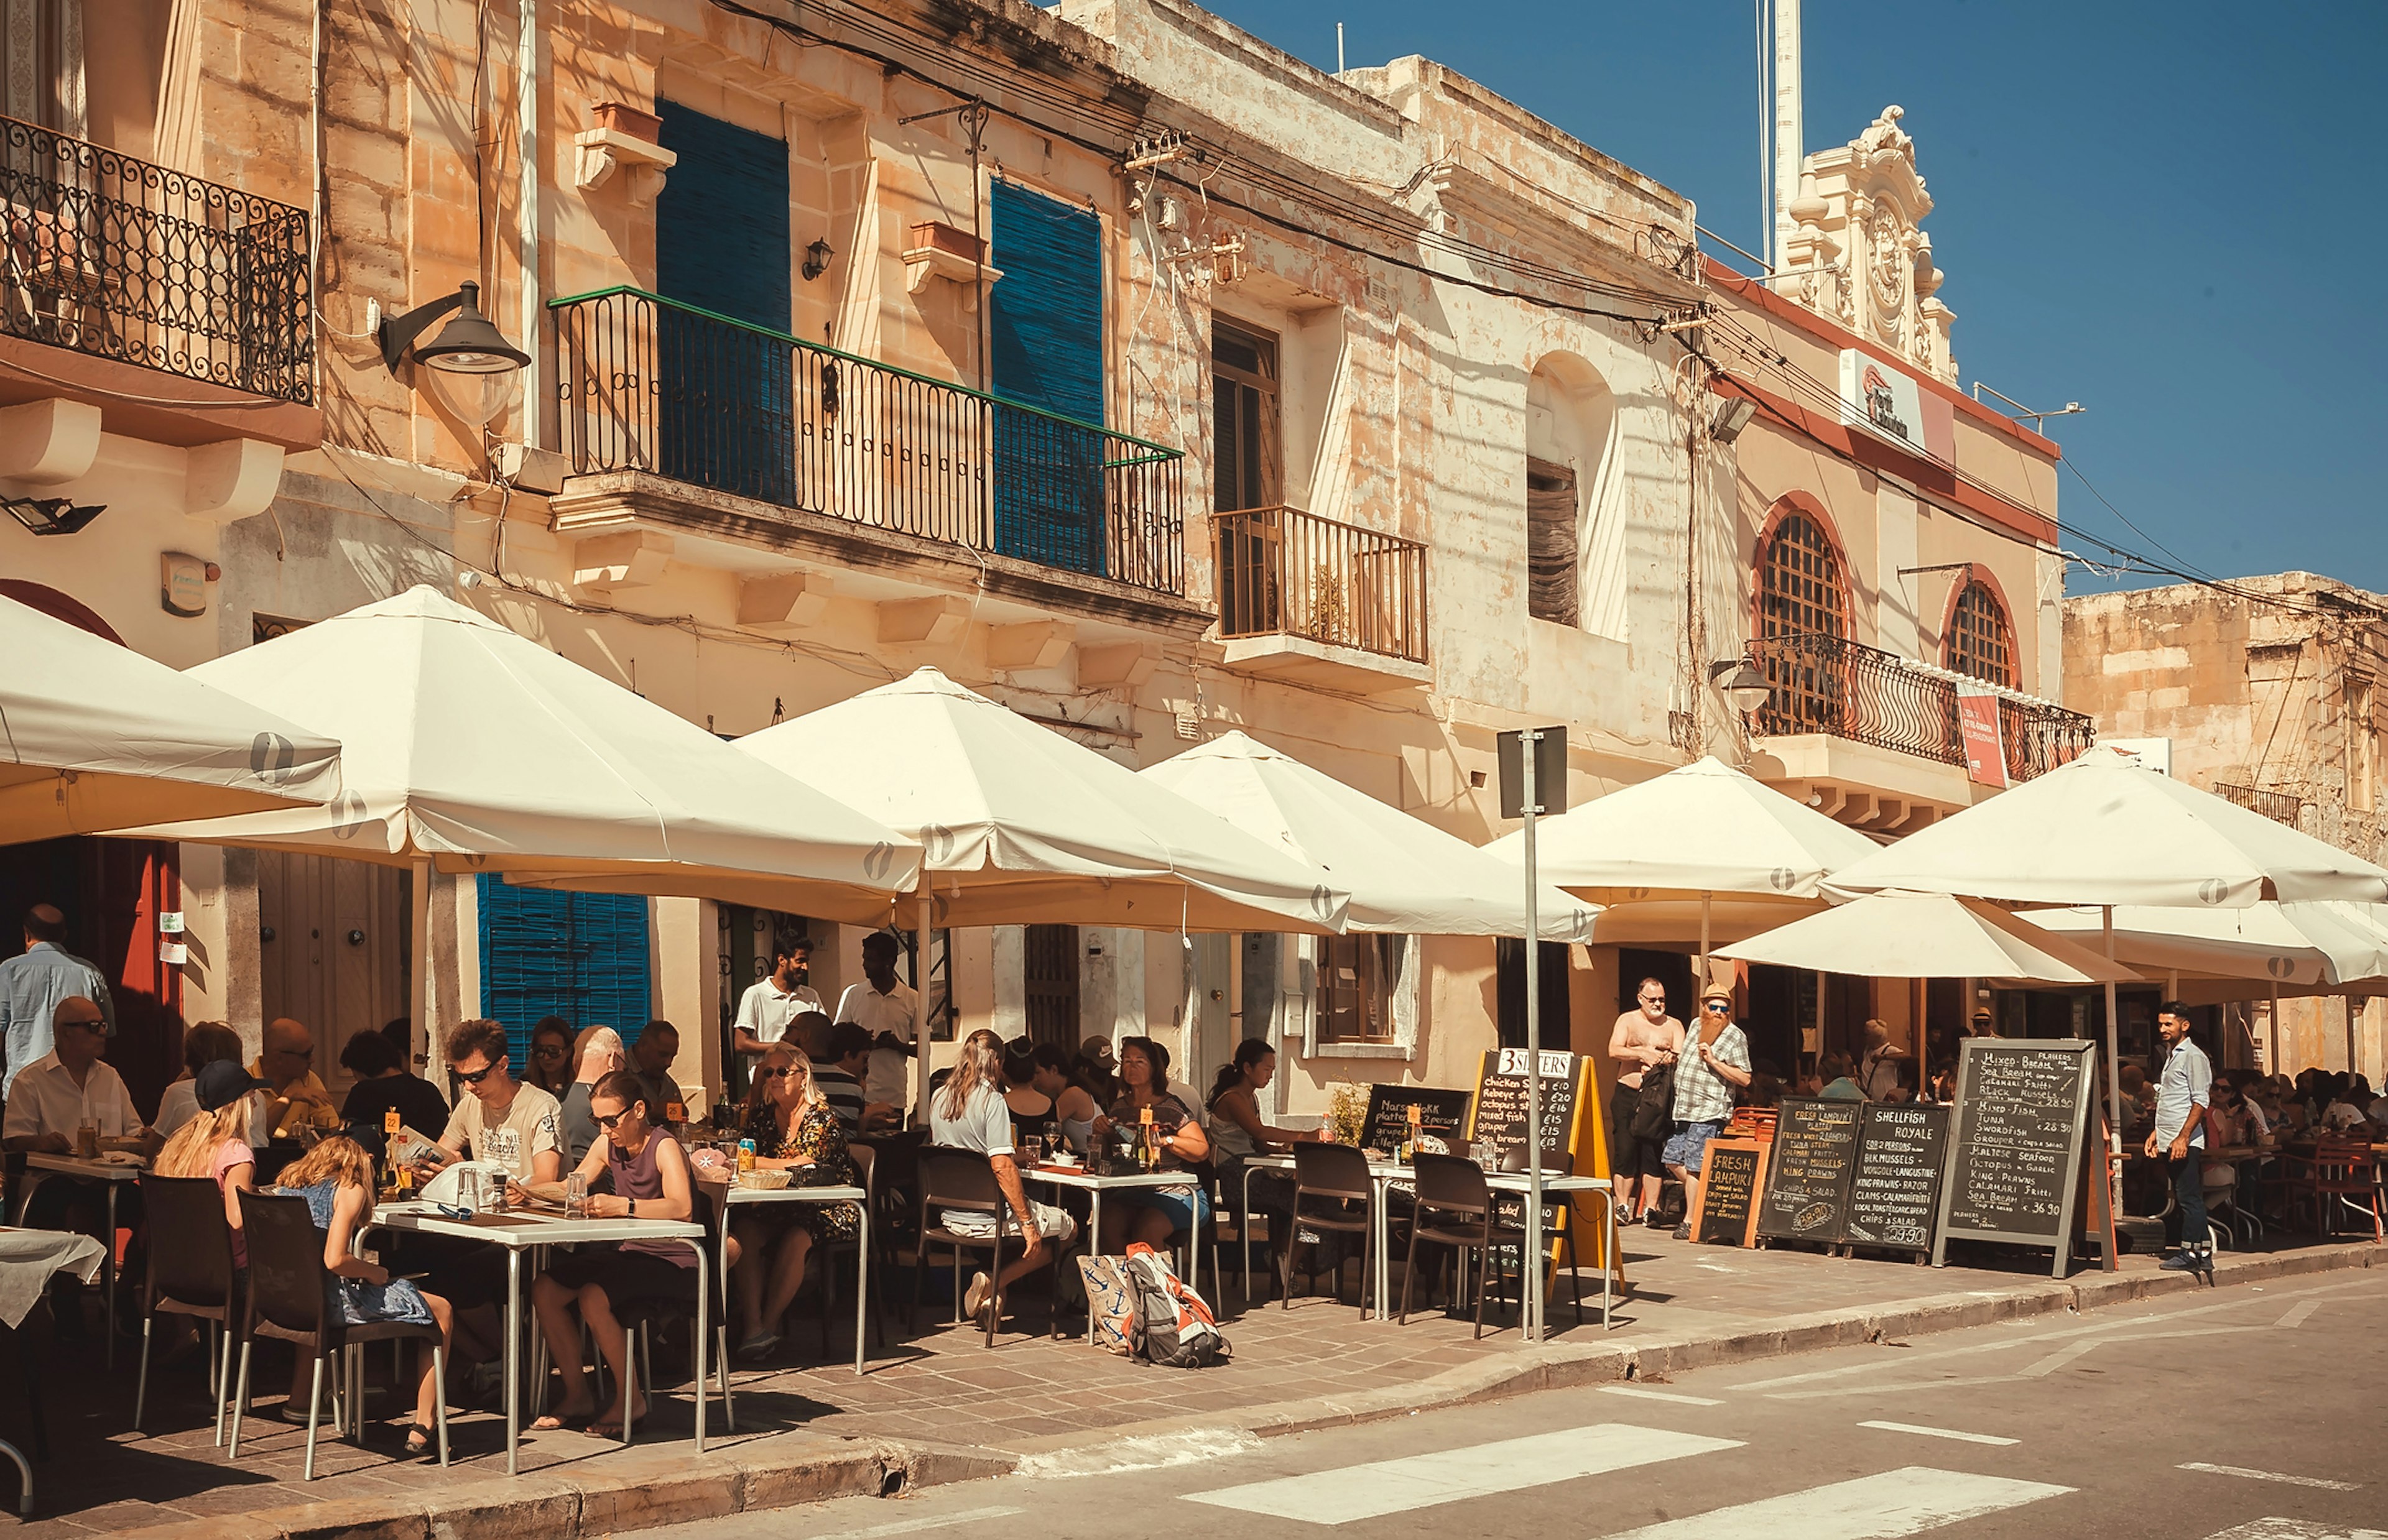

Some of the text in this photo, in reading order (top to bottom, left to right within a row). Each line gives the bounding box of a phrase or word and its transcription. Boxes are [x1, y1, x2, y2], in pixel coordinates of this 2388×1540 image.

[1502, 1050, 1568, 1074] 3 SIERS
[1481, 1100, 1516, 1112] octopus
[387, 1118, 396, 1127] 22
[1506, 1112, 1526, 1122] fish
[1976, 1112, 2004, 1124] TUNA
[1376, 1128, 1402, 1138] grupe
[1478, 1122, 1509, 1133] gruper
[1894, 1126, 1933, 1140] ROYALE
[1497, 1134, 1527, 1144] bream
[1879, 1141, 1884, 1150] 2
[1713, 1155, 1751, 1171] FRESH
[1879, 1153, 1914, 1164] MUSSELS
[1970, 1169, 1994, 1181] KING
[1902, 1181, 1928, 1191] RAZOR
[1892, 1217, 1917, 1225] SALAD
